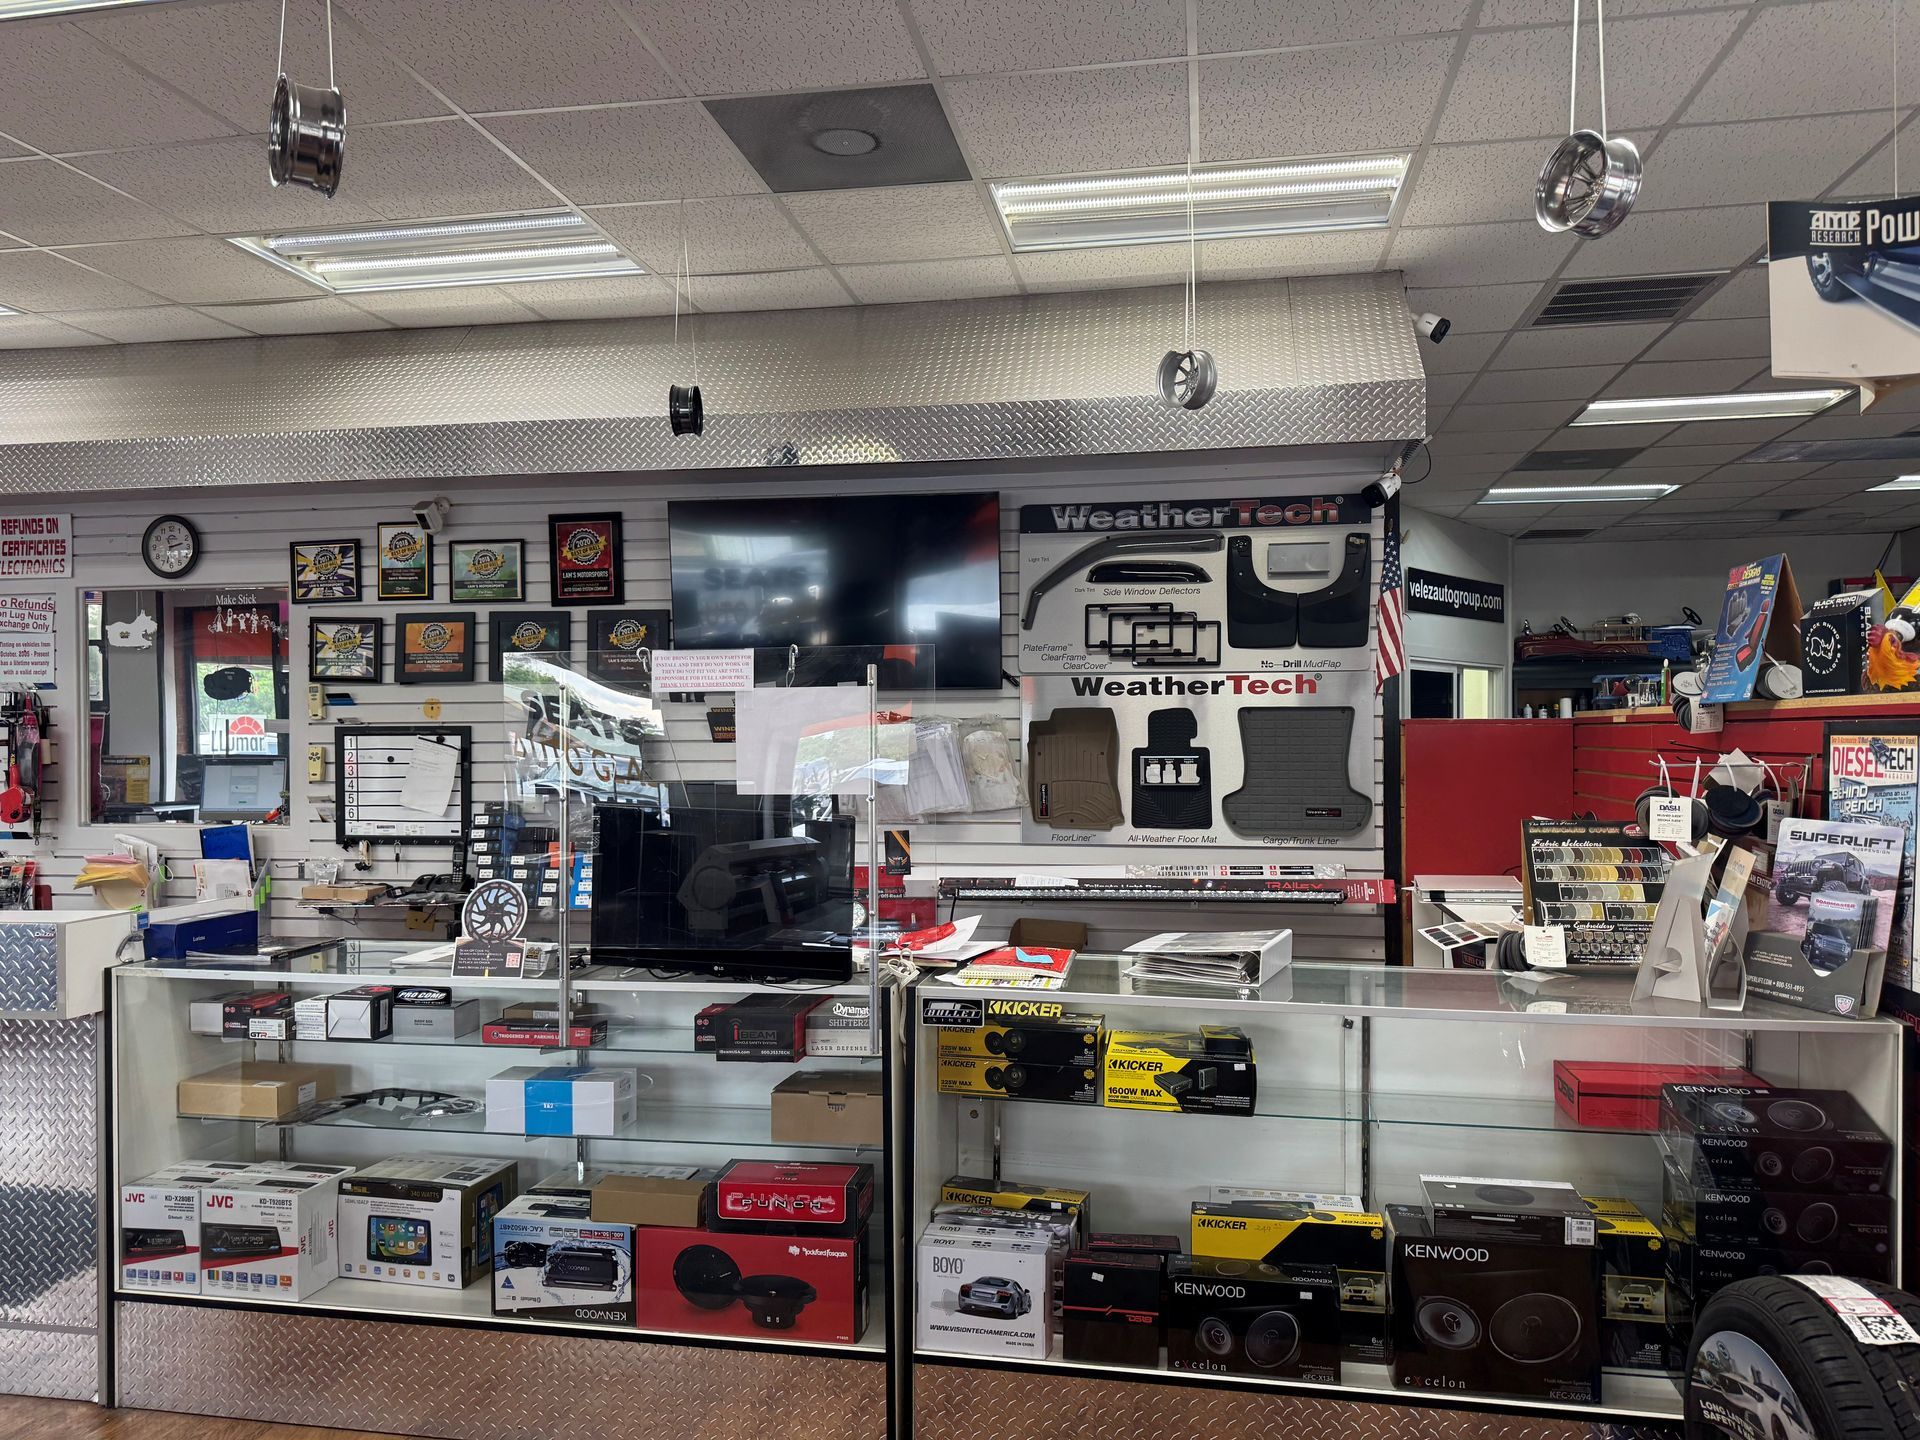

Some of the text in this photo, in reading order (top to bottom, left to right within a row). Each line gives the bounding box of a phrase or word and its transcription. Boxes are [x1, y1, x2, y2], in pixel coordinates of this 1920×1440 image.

[1811, 230, 1860, 243] RESEARCH
[1, 517, 59, 535] REFUNDS ON
[2, 539, 66, 557] CERTIFICATES
[1103, 585, 1201, 596] Side Window Deflectors
[1409, 578, 1502, 612] velezautogroup.com
[216, 594, 256, 604] Make Stick
[1836, 596, 1857, 604] RHINO
[11, 598, 54, 611] Refunds
[9, 611, 47, 621] Lug Nuts
[0, 620, 49, 632] xchange Only
[1823, 622, 1840, 640] RHINO
[1303, 659, 1342, 669] MudFlap
[1072, 674, 1318, 698] WeatherTech
[348, 752, 354, 762] 2
[1832, 746, 1883, 778] DIESEL
[348, 766, 354, 776] 3
[348, 780, 355, 790] 4
[1832, 785, 1868, 800] BEHIND
[348, 794, 355, 804] 5
[348, 808, 355, 818] 6
[1128, 834, 1176, 844] All-Weather
[1178, 835, 1200, 843] Floor
[1263, 836, 1340, 846] Cargo/Trunk Liner
[1531, 839, 1602, 848] Fabric Selections
[1789, 830, 1896, 850] SUPERLIFT
[1852, 847, 1891, 855] SUSPENSION
[1815, 898, 1856, 909] ROADMASTER
[1573, 921, 1615, 931] Embroidery
[418, 991, 447, 999] COMP
[1001, 1001, 1063, 1017] KICKER
[829, 1019, 868, 1028] SHIFTERZ
[1118, 1060, 1163, 1072] KICKER
[1108, 1087, 1163, 1097] 1600W MAX
[1673, 1086, 1750, 1095] KENWOOD
[1702, 1138, 1748, 1148] KENWOOD
[125, 1193, 145, 1203] JVC
[206, 1195, 233, 1208] JVC
[954, 1192, 992, 1206] KICKER
[1705, 1193, 1750, 1203] KENWOOD
[1206, 1219, 1247, 1230] KICKER
[1404, 1244, 1489, 1262] KENWOOD
[1700, 1250, 1745, 1260] KENWOOD
[933, 1256, 964, 1274] BOYO
[1292, 1276, 1333, 1284] KENWOOD
[1174, 1282, 1246, 1298] KENWOOD
[575, 1308, 627, 1321] KENWOOD
[929, 1324, 1036, 1339] WWW.VISIONTECHAMERICA.COM
[1302, 1373, 1334, 1382] KFC-X134
[1550, 1391, 1592, 1401] KFC-X694
[1700, 1400, 1726, 1415] LONG
[1703, 1409, 1736, 1429] SAFETY
